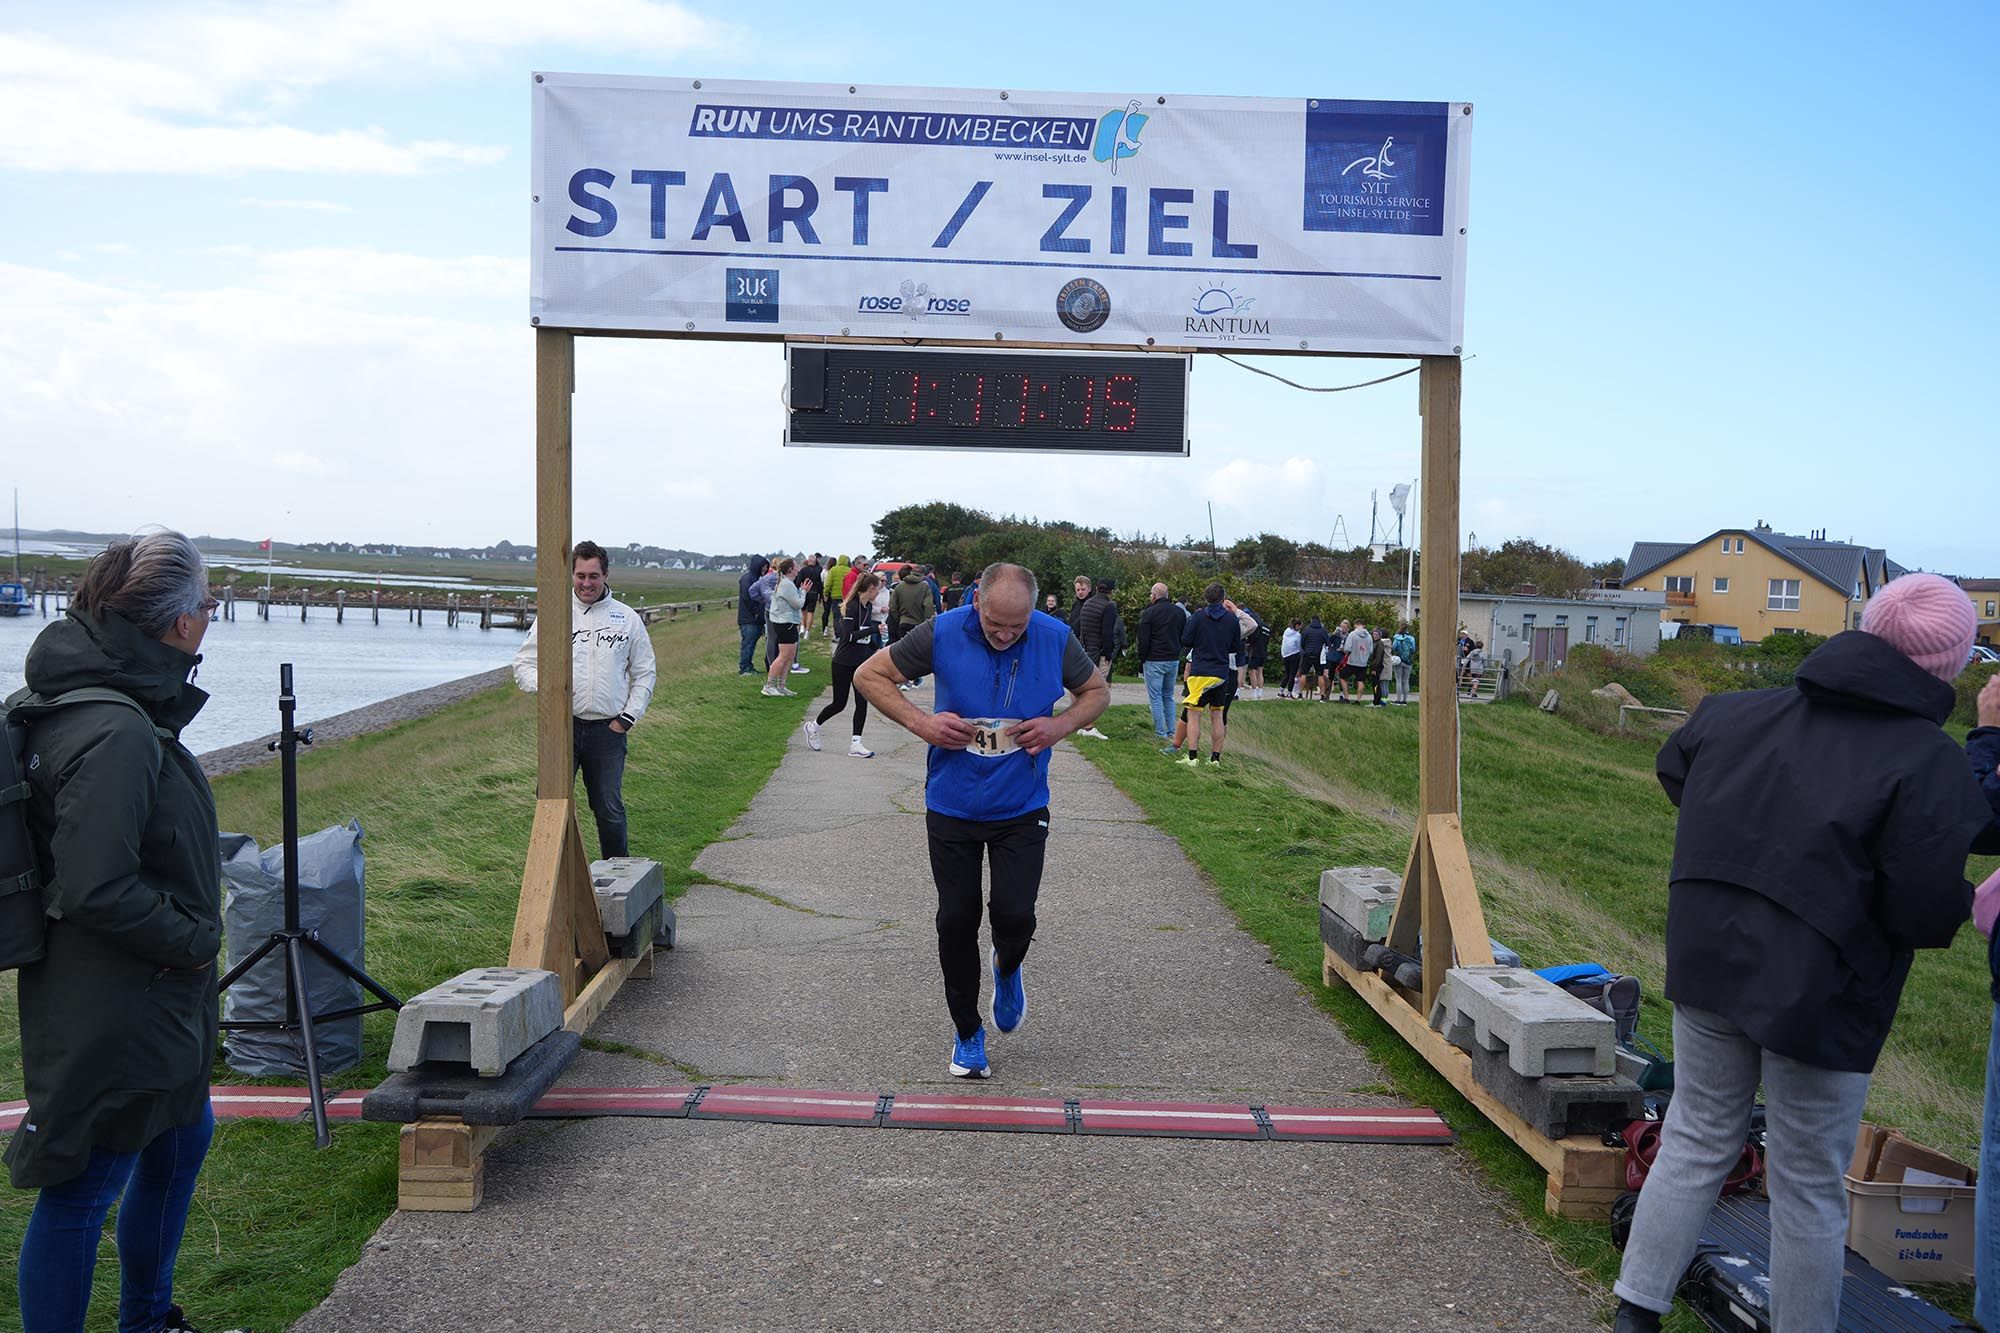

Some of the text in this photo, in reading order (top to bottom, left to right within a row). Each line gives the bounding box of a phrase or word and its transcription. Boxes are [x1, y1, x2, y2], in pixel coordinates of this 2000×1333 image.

[695, 108, 1090, 145] RUN UMS RANTUMBECKEN
[994, 151, 1088, 164] www.insel-sylt.de
[1360, 182, 1391, 194] SYLT
[1320, 193, 1431, 209] TOURISMUS-SERVICE
[565, 167, 1259, 260] START / ZIEL
[1337, 207, 1411, 220] INSEL-SYLT.DE
[858, 295, 971, 312] rose rose
[1184, 316, 1271, 335] RANTUM
[911, 374, 1138, 430] 1:11:15
[974, 729, 999, 751] 41
[1895, 1228, 1949, 1240] Fundsachen
[1899, 1248, 1943, 1260] Eisbahn
